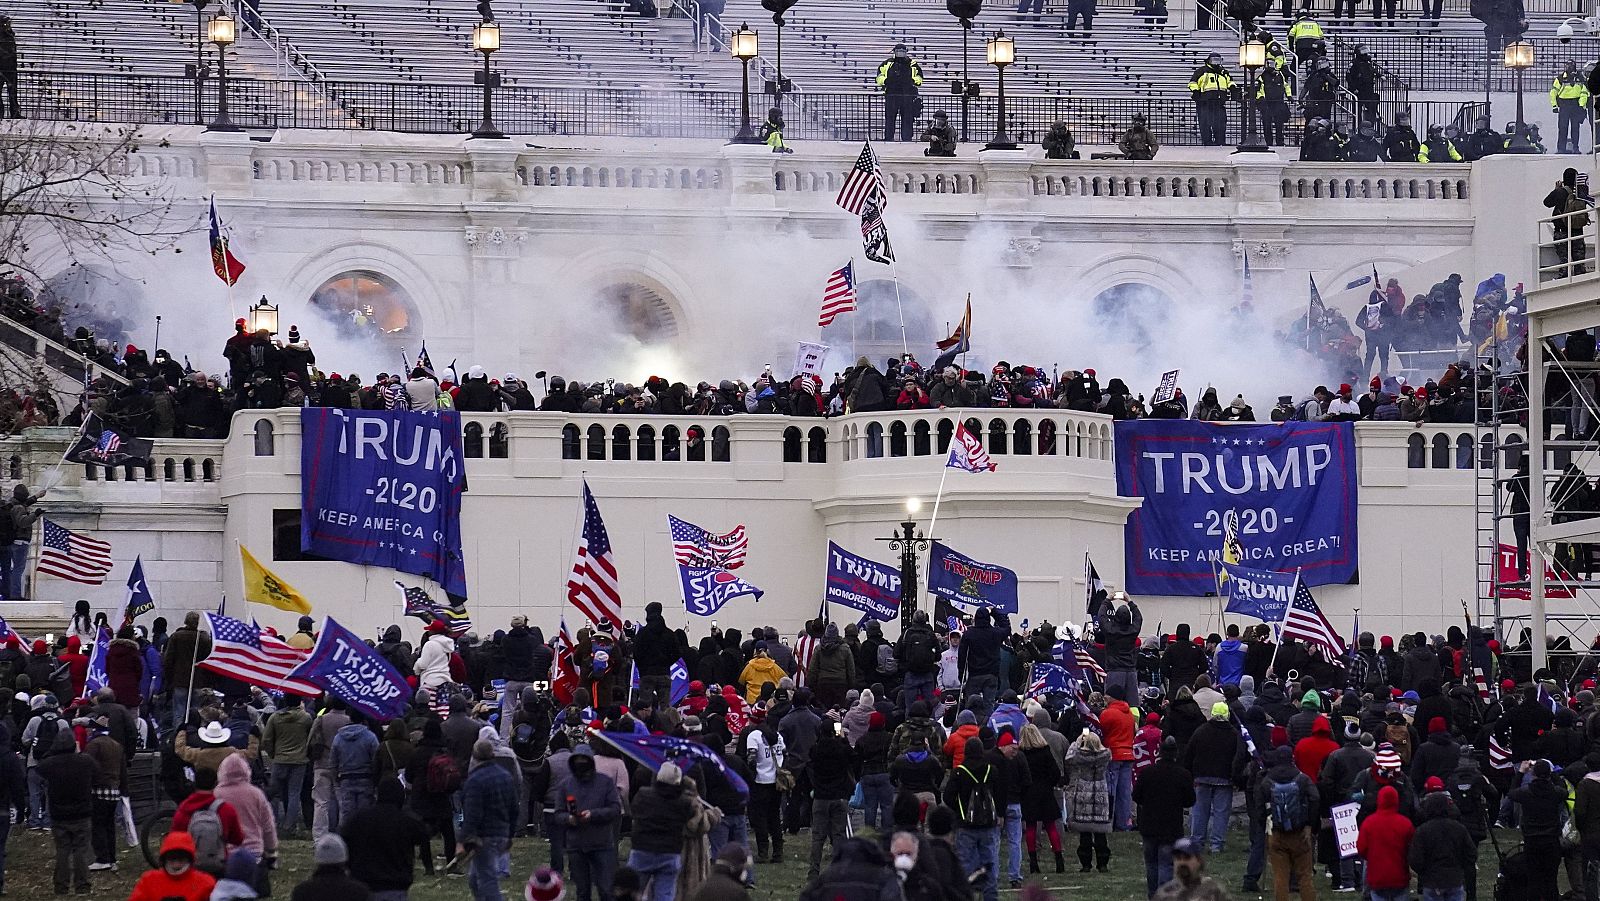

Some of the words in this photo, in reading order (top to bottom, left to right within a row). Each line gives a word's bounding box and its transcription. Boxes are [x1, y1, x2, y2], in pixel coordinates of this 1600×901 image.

[1142, 443, 1332, 494] TRUMP
[318, 508, 358, 527] KEEP
[1149, 547, 1190, 562] KEEP
[1196, 546, 1275, 562] AMICA
[832, 549, 902, 592] TRUMP
[942, 557, 1003, 585] TRUMP
[693, 582, 754, 614] STEAL
[828, 586, 842, 596] NO
[841, 591, 867, 605] MORE
[937, 586, 955, 595] KEEP
[955, 593, 984, 604] AMERICA
[1334, 808, 1353, 820] KEEP
[1338, 827, 1349, 836] TO
